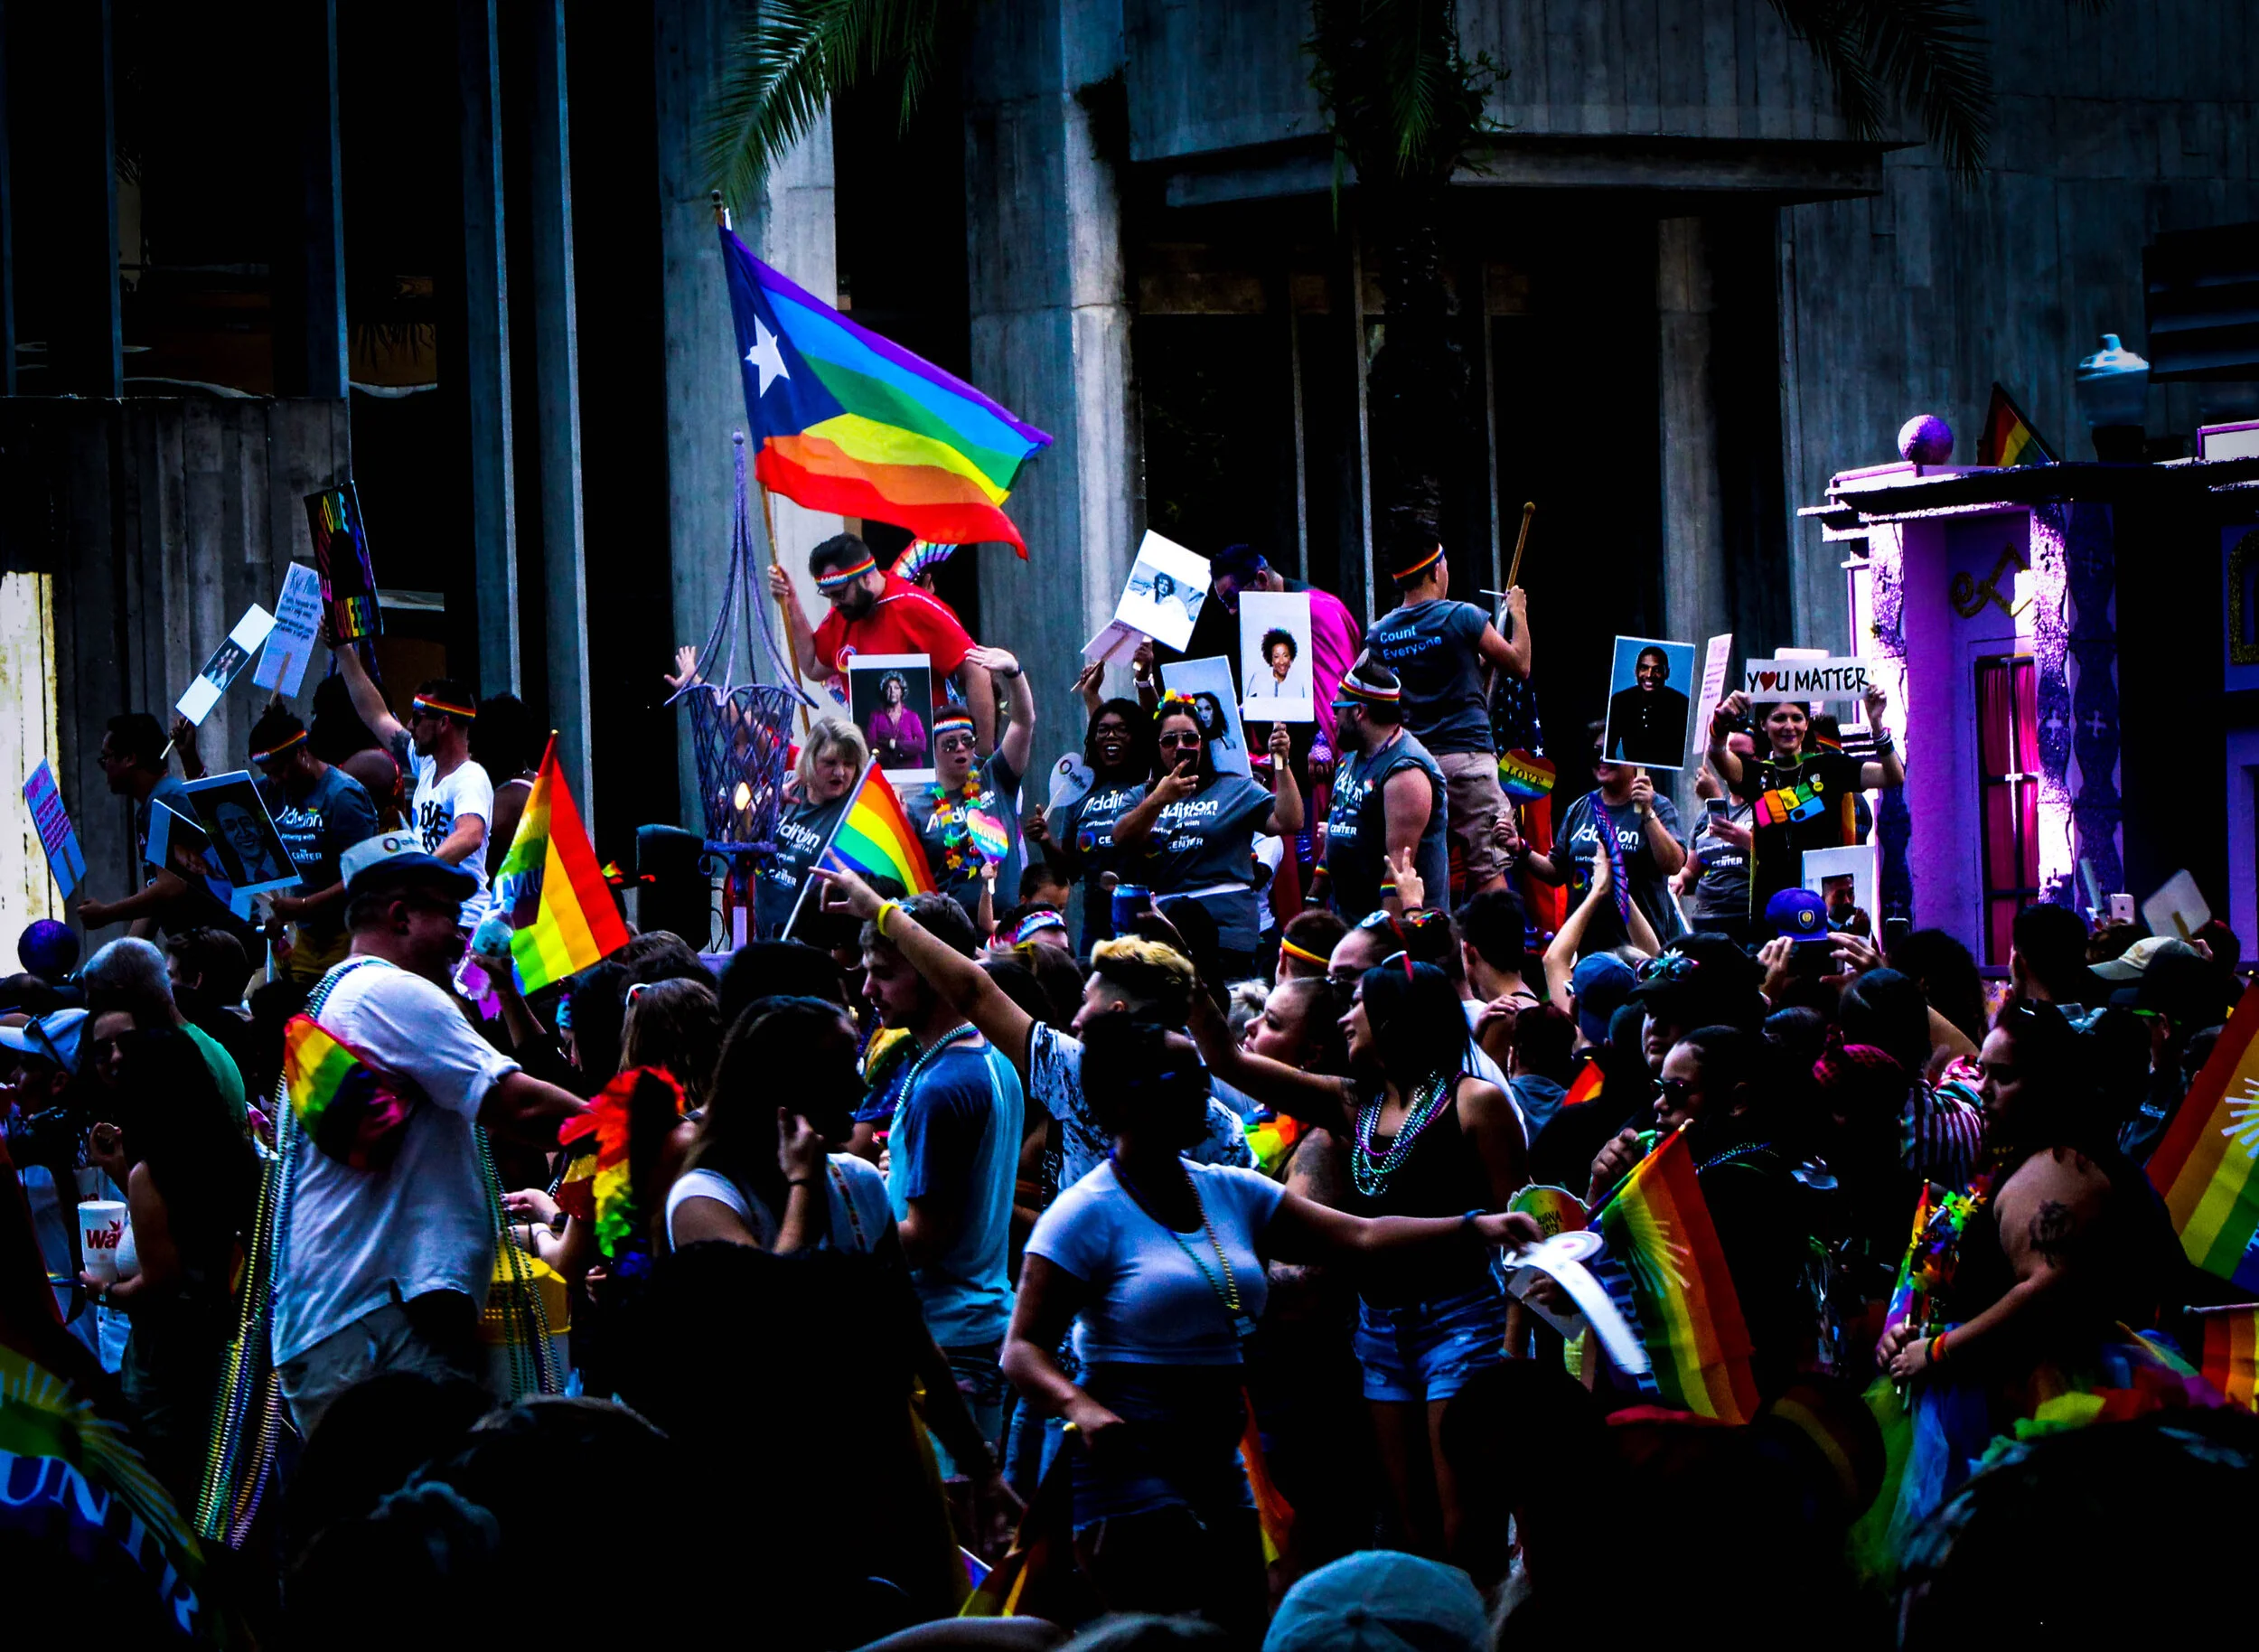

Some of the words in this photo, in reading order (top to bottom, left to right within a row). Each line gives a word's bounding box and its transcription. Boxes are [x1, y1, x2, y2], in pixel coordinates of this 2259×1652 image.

[1380, 625, 1416, 643] Count
[1383, 636, 1441, 660] Everyone
[1794, 666, 1870, 692] MATTER
[1330, 823, 1357, 836] CENTER
[1167, 837, 1204, 850] CENTER
